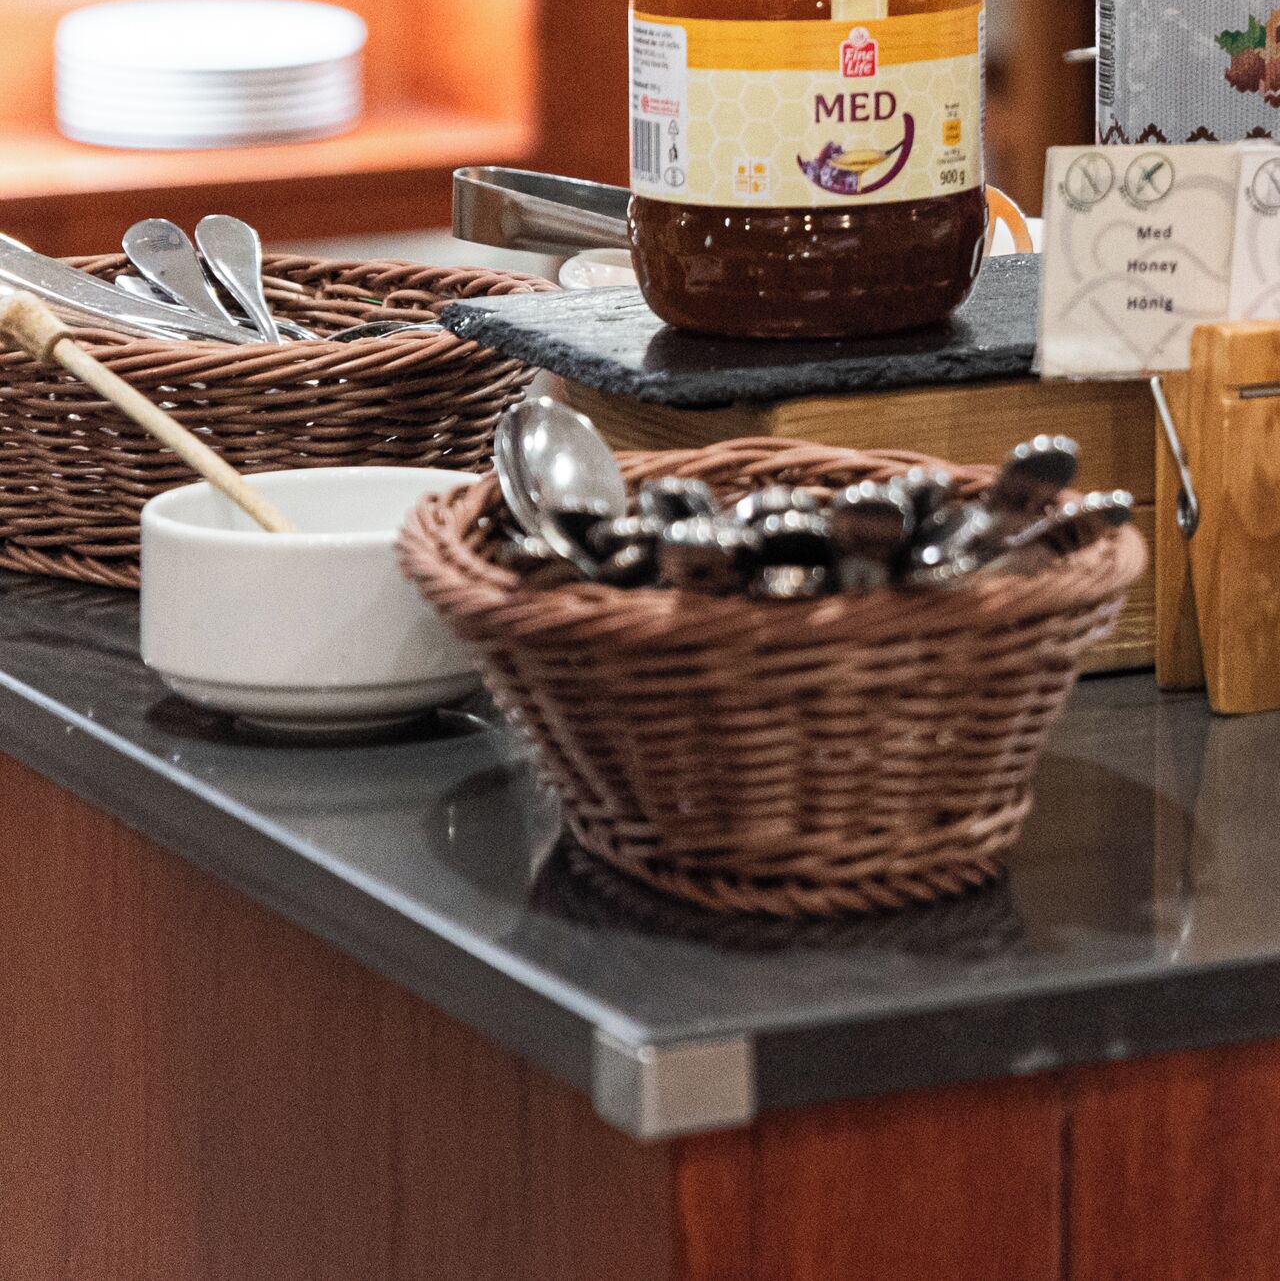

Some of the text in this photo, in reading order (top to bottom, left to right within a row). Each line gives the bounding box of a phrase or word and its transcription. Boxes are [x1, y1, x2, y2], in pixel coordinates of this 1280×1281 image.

[844, 47, 875, 63] Fine
[845, 59, 874, 76] Life
[814, 90, 897, 124] MED
[939, 169, 957, 185] 900
[1136, 224, 1172, 241] Med
[1126, 257, 1178, 275] Honey
